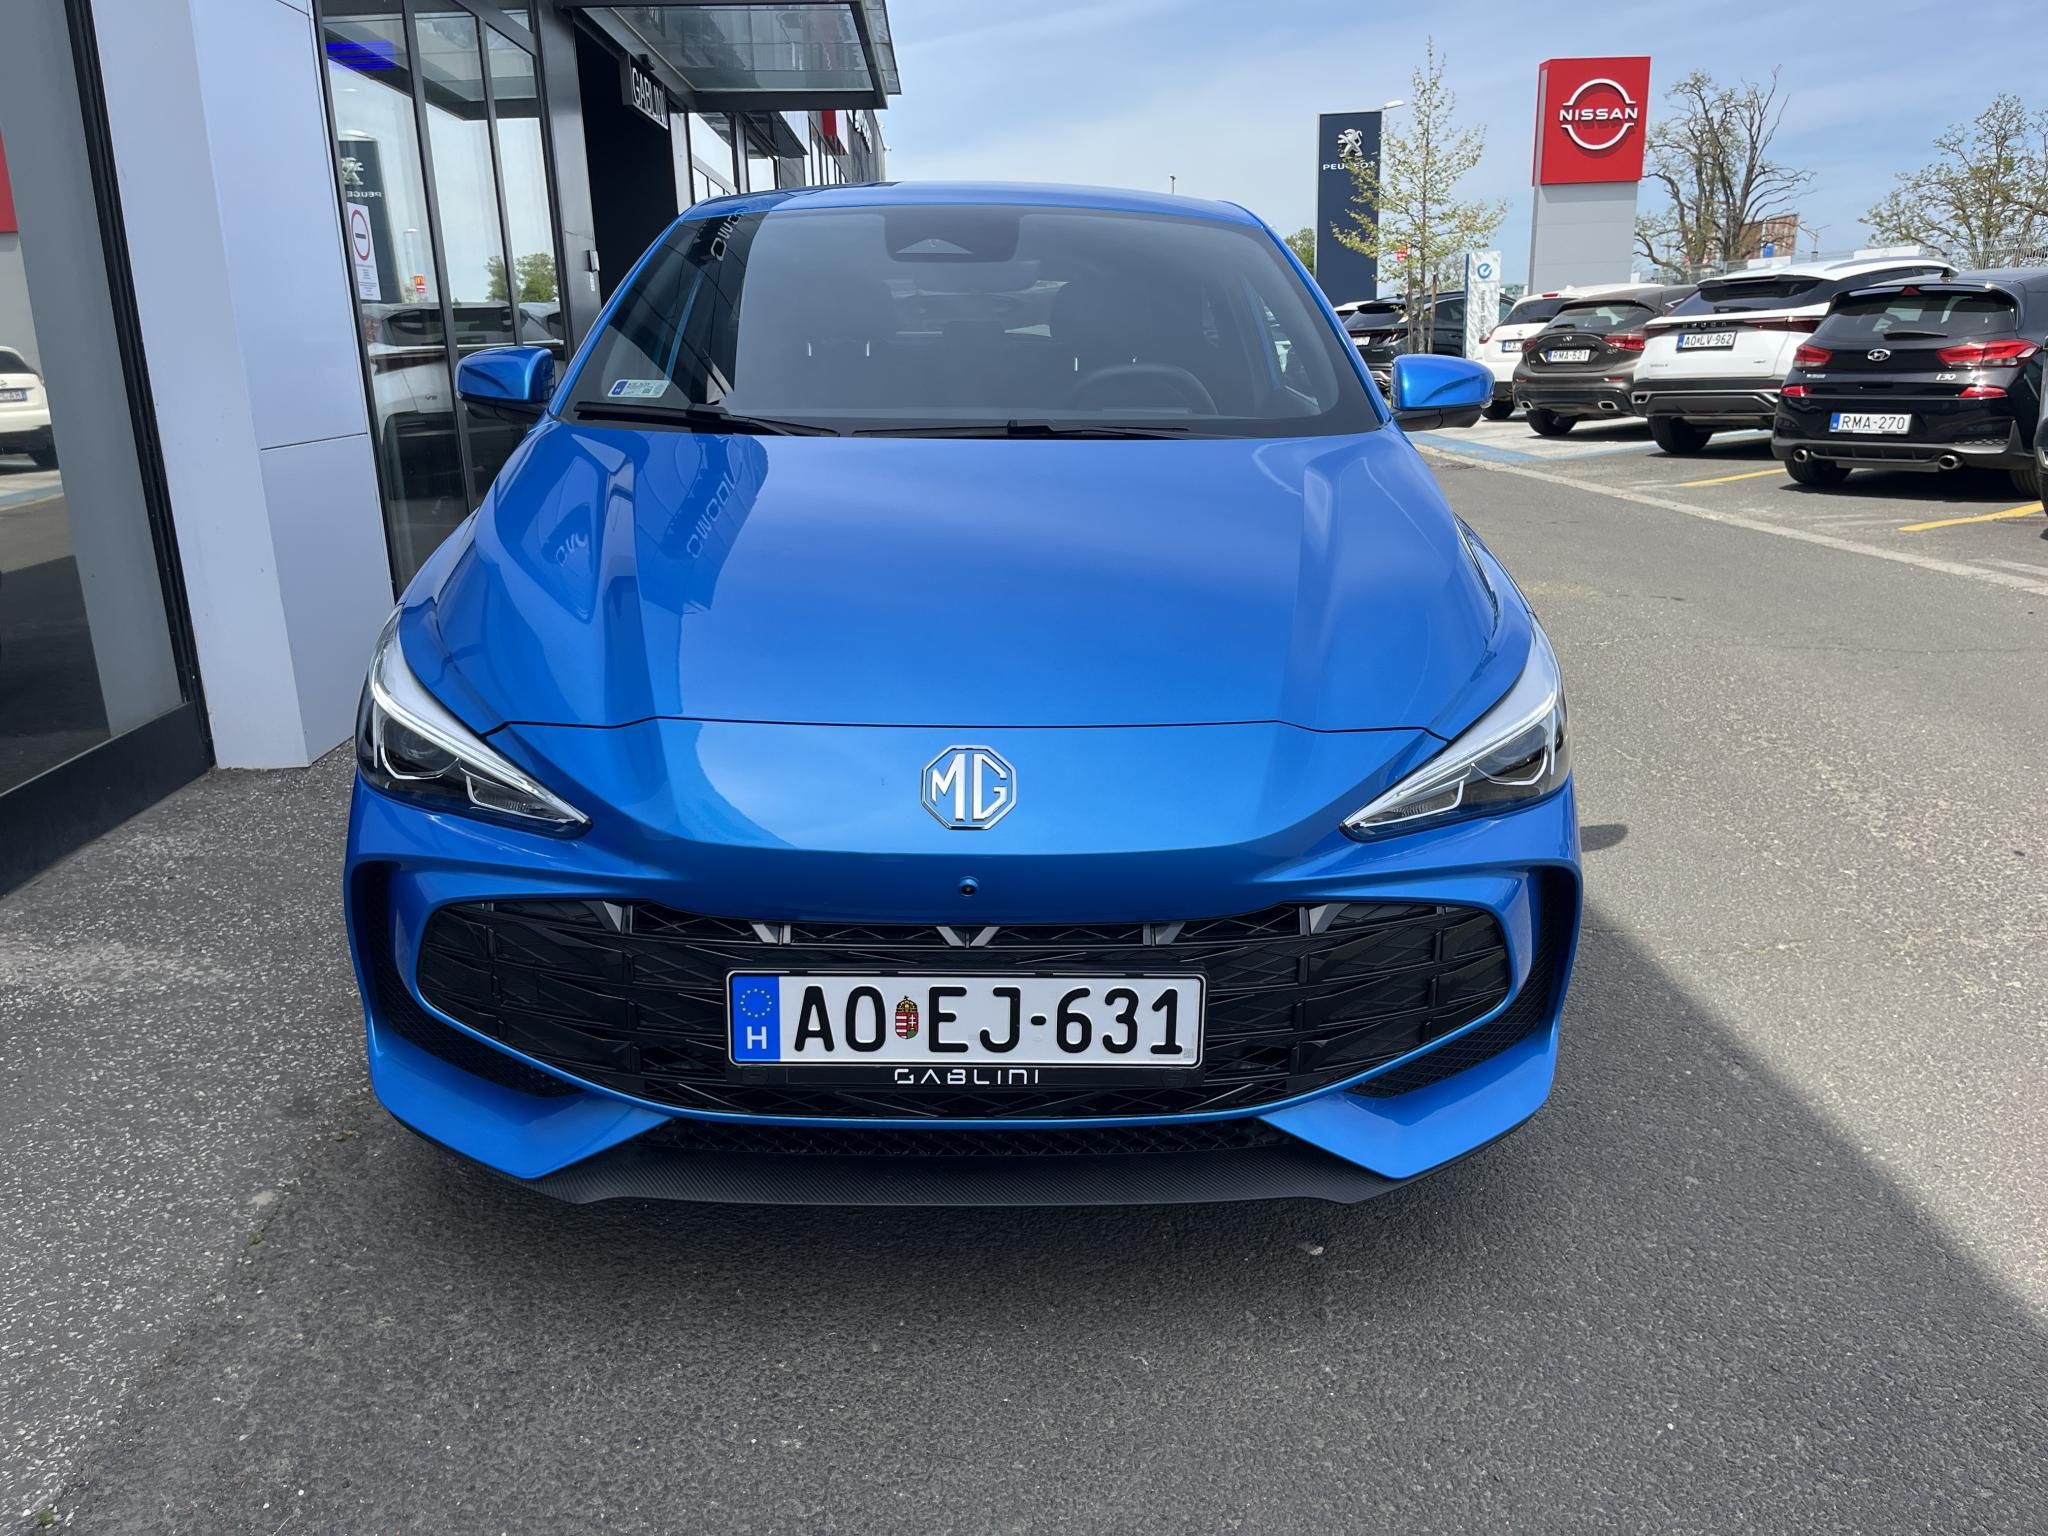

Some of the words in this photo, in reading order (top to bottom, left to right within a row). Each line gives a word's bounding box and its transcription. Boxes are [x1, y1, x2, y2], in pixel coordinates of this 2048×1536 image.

[1559, 107, 1638, 121] NISSAN
[1322, 161, 1377, 170] PEUEO
[1841, 415, 1906, 430] RMA-270
[930, 753, 1008, 821] MG
[928, 986, 1184, 1055] EJ-631
[746, 1026, 767, 1050] H
[894, 1068, 1039, 1085] GABLINI
